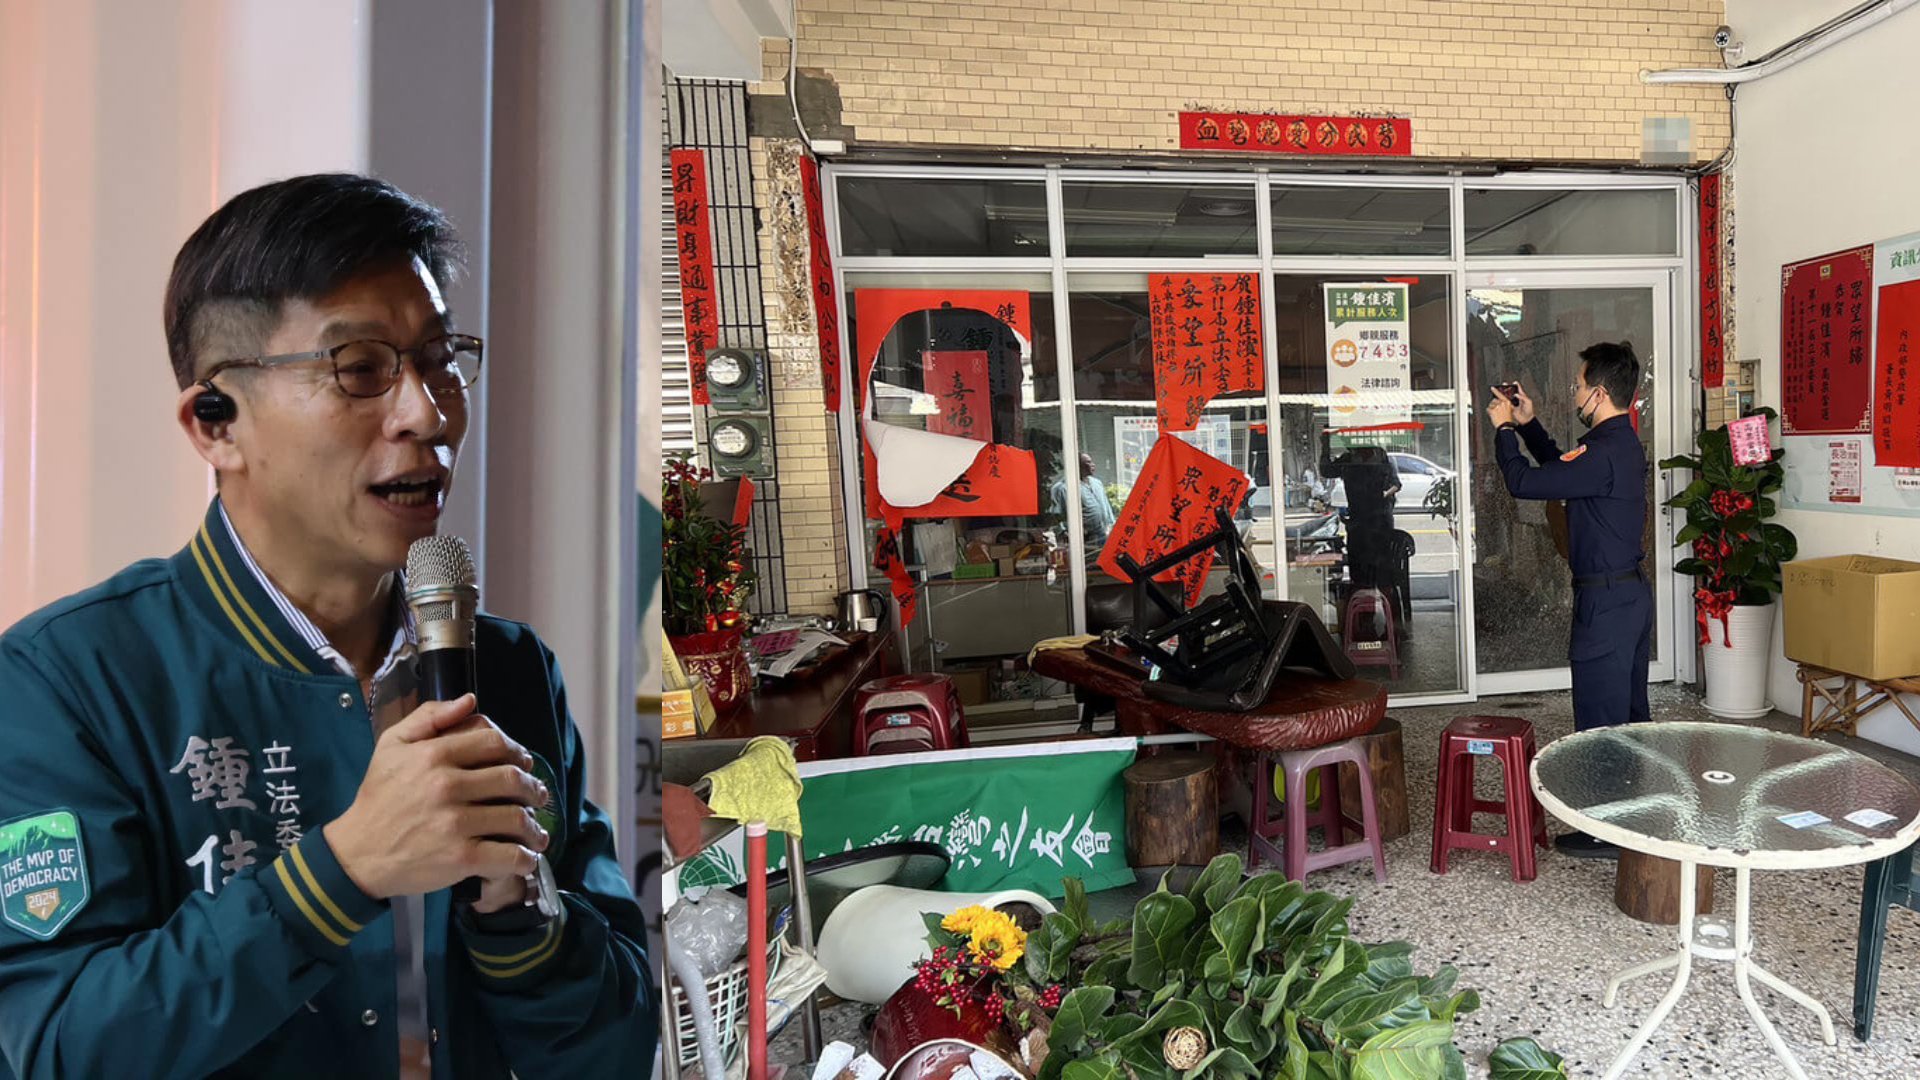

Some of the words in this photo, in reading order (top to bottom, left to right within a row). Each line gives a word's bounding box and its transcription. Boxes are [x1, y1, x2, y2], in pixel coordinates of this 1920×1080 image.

[2, 857, 24, 879] THE
[26, 849, 54, 869] MVP
[58, 848, 75, 864] OF
[4, 866, 78, 898] DEMOCRACY
[28, 890, 57, 908] 2024
